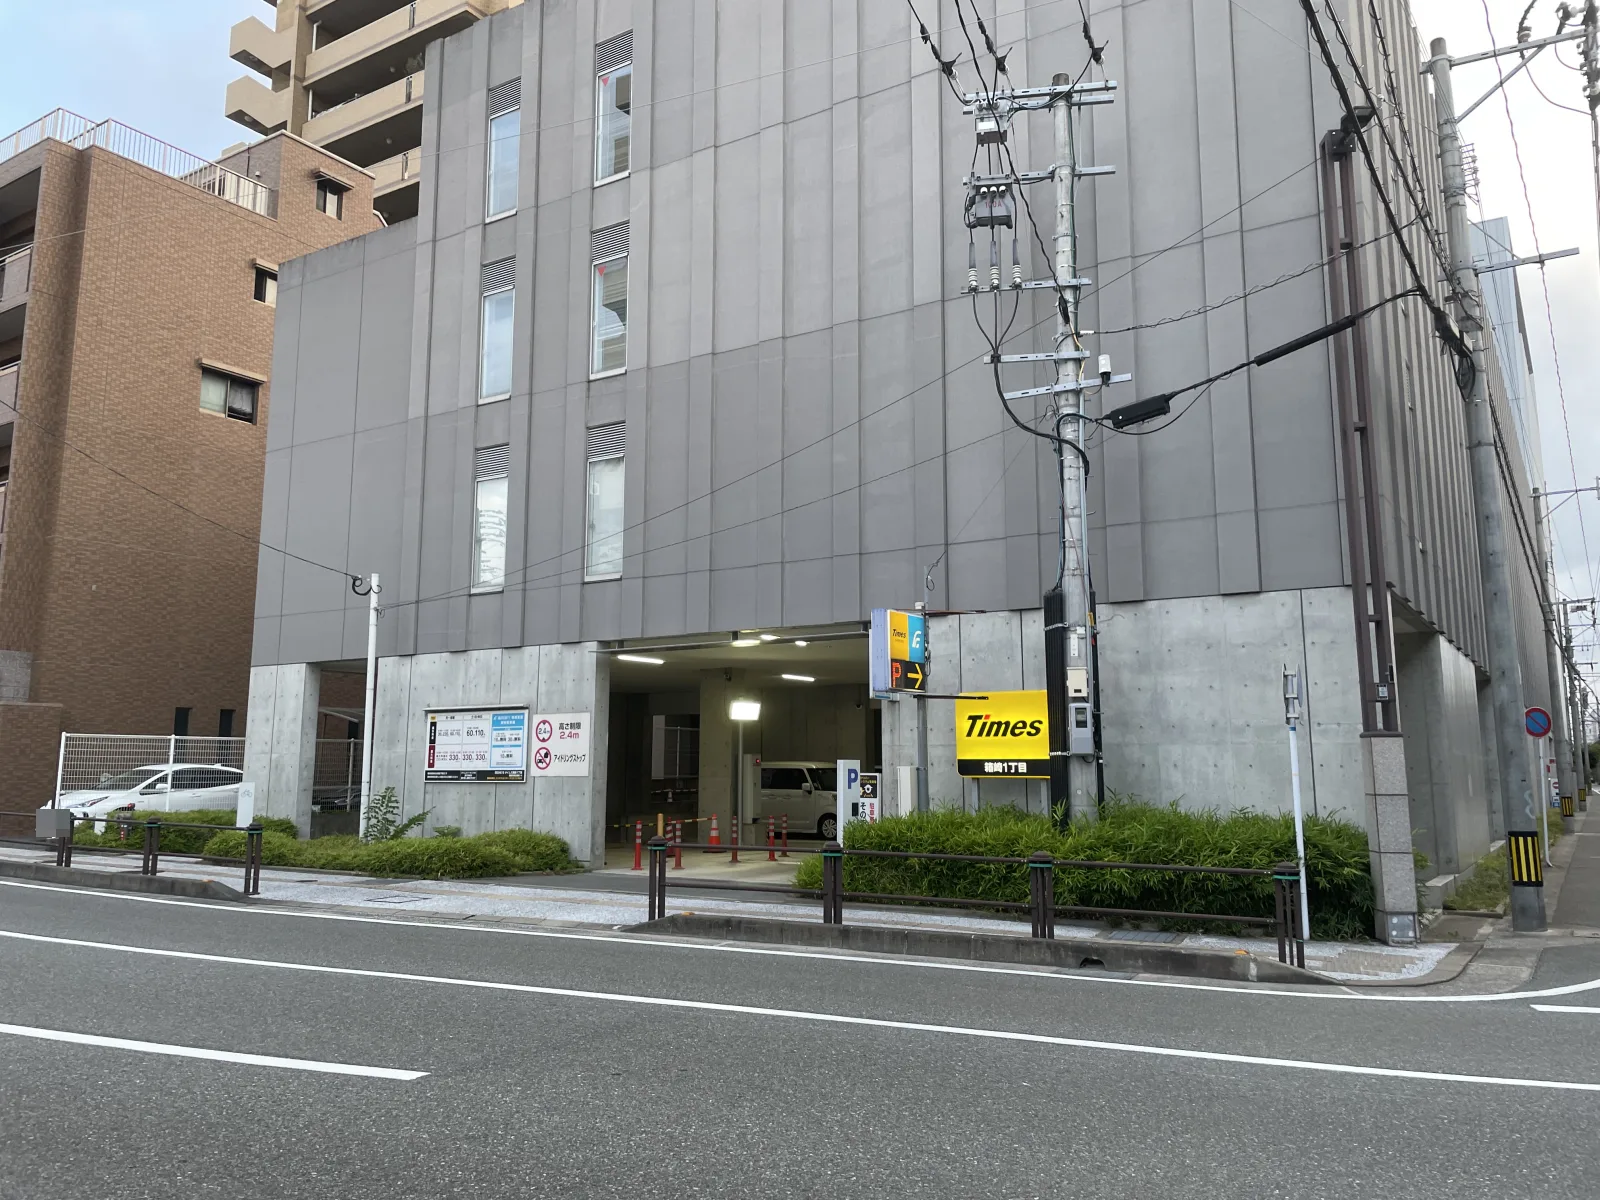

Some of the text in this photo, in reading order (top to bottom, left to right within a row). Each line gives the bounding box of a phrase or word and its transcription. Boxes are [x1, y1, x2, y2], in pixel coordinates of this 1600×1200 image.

[892, 628, 907, 639] Times
[892, 662, 901, 688] P
[558, 722, 581, 730] 高さ制限
[965, 714, 1043, 737] Times
[559, 731, 580, 739] 2.4m
[553, 754, 586, 763] アイドリングストップ
[847, 768, 859, 790] P
